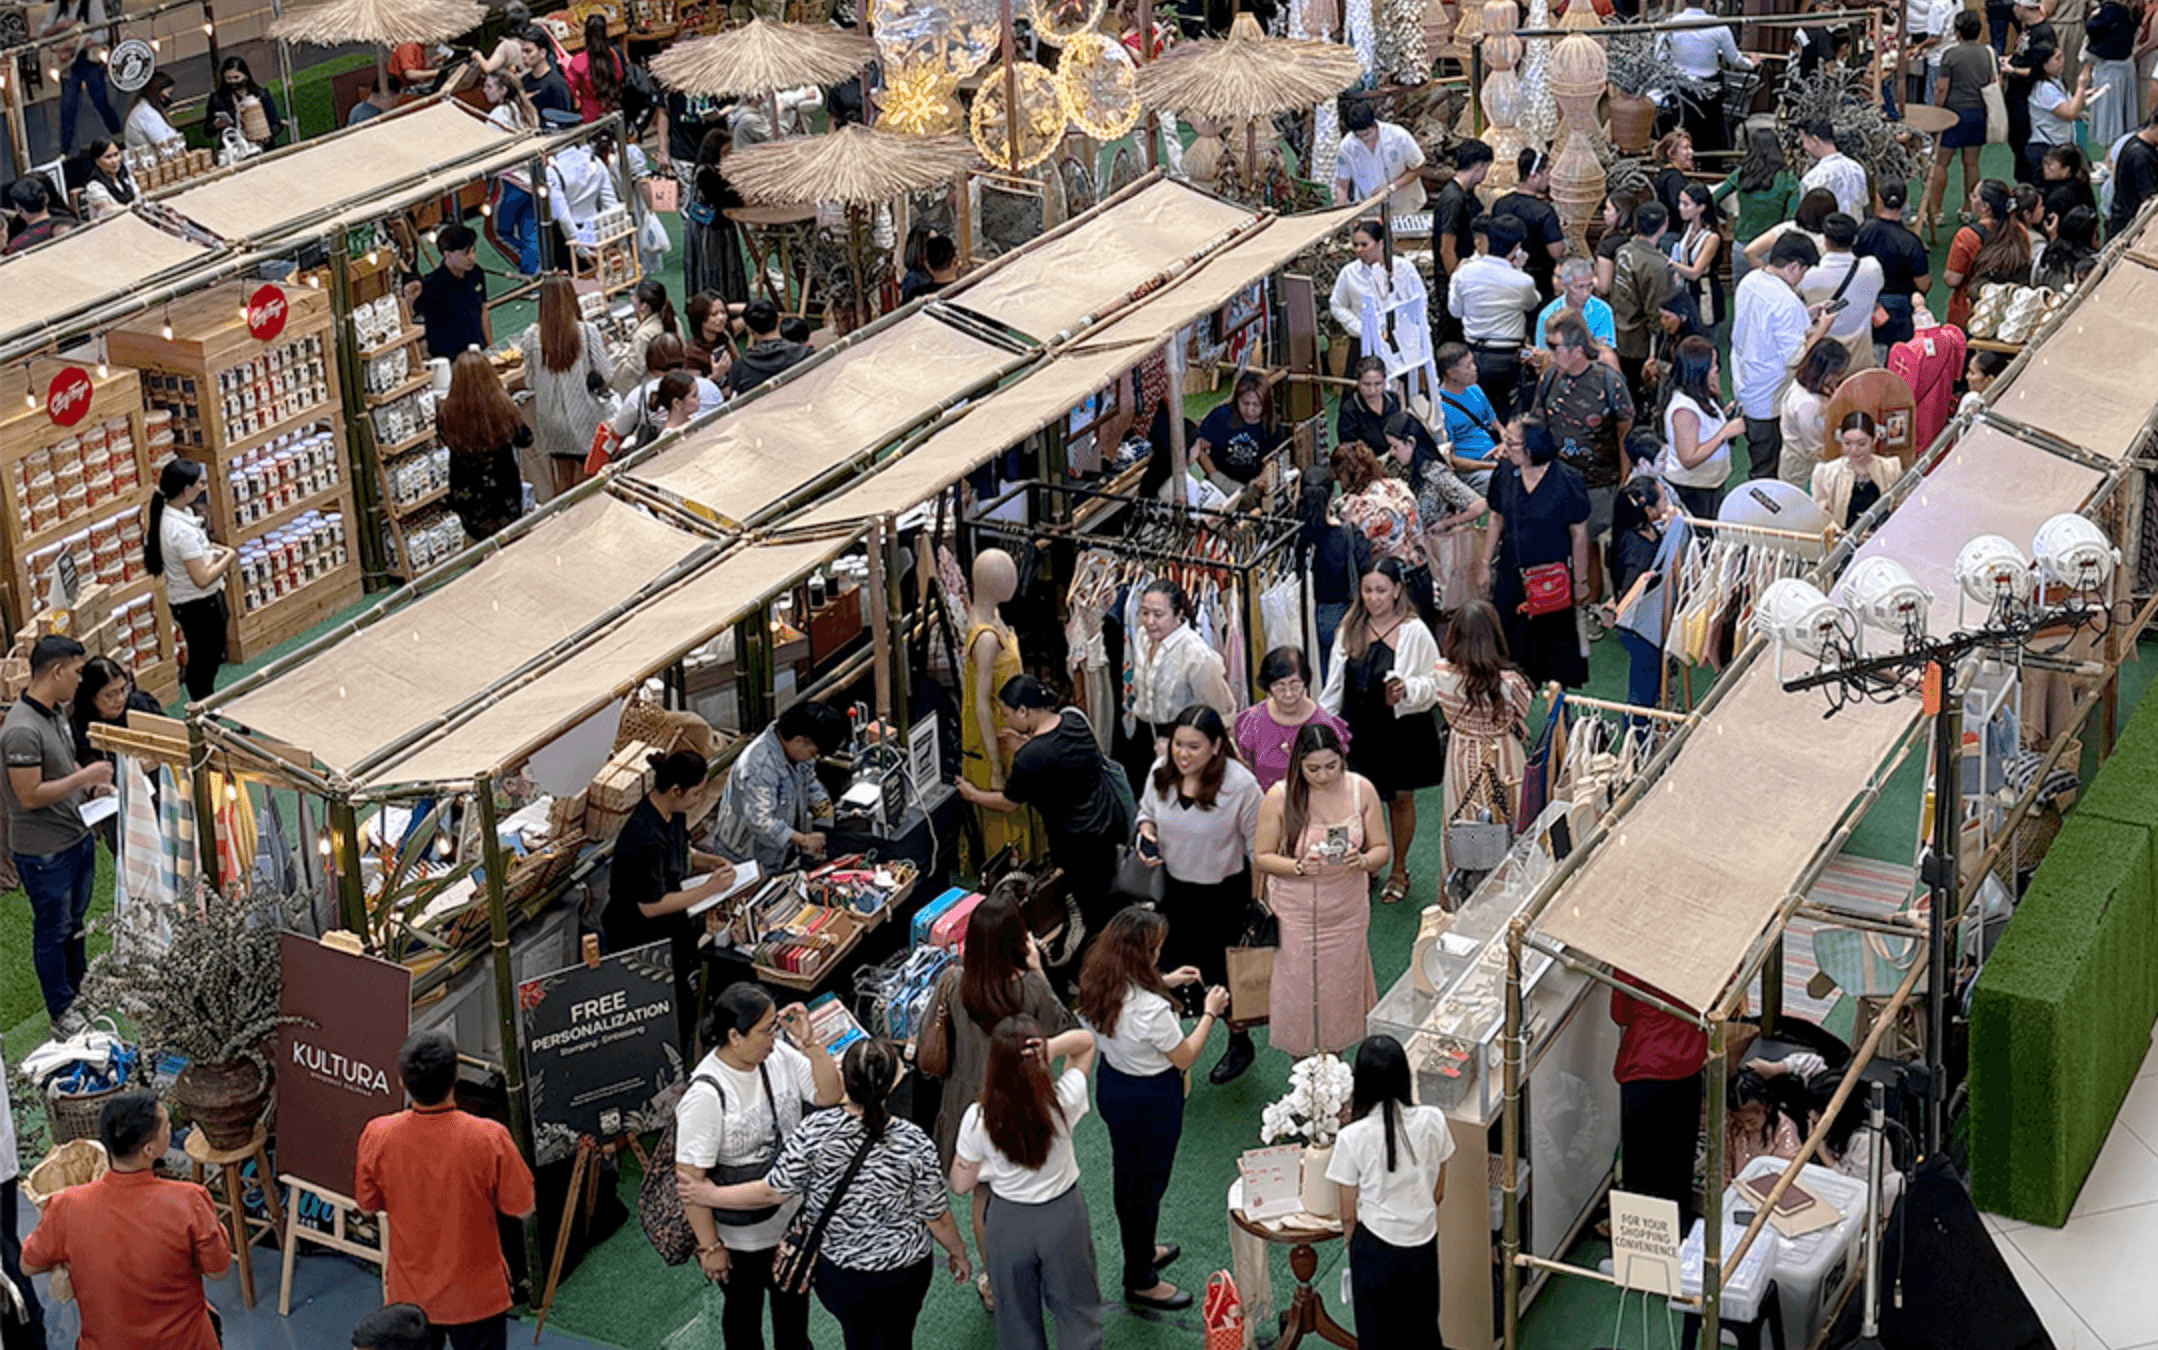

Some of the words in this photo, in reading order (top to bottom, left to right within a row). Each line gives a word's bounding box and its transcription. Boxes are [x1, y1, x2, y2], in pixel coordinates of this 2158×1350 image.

[570, 990, 628, 1023] FREE
[531, 1000, 671, 1053] PERSONALIZATION
[293, 1041, 390, 1095] KULTURA
[1620, 1225, 1671, 1245] SHOPPING
[1621, 1213, 1640, 1226] FOR
[1642, 1217, 1668, 1232] YOUR
[1615, 1235, 1677, 1258] CONVENIENCE
